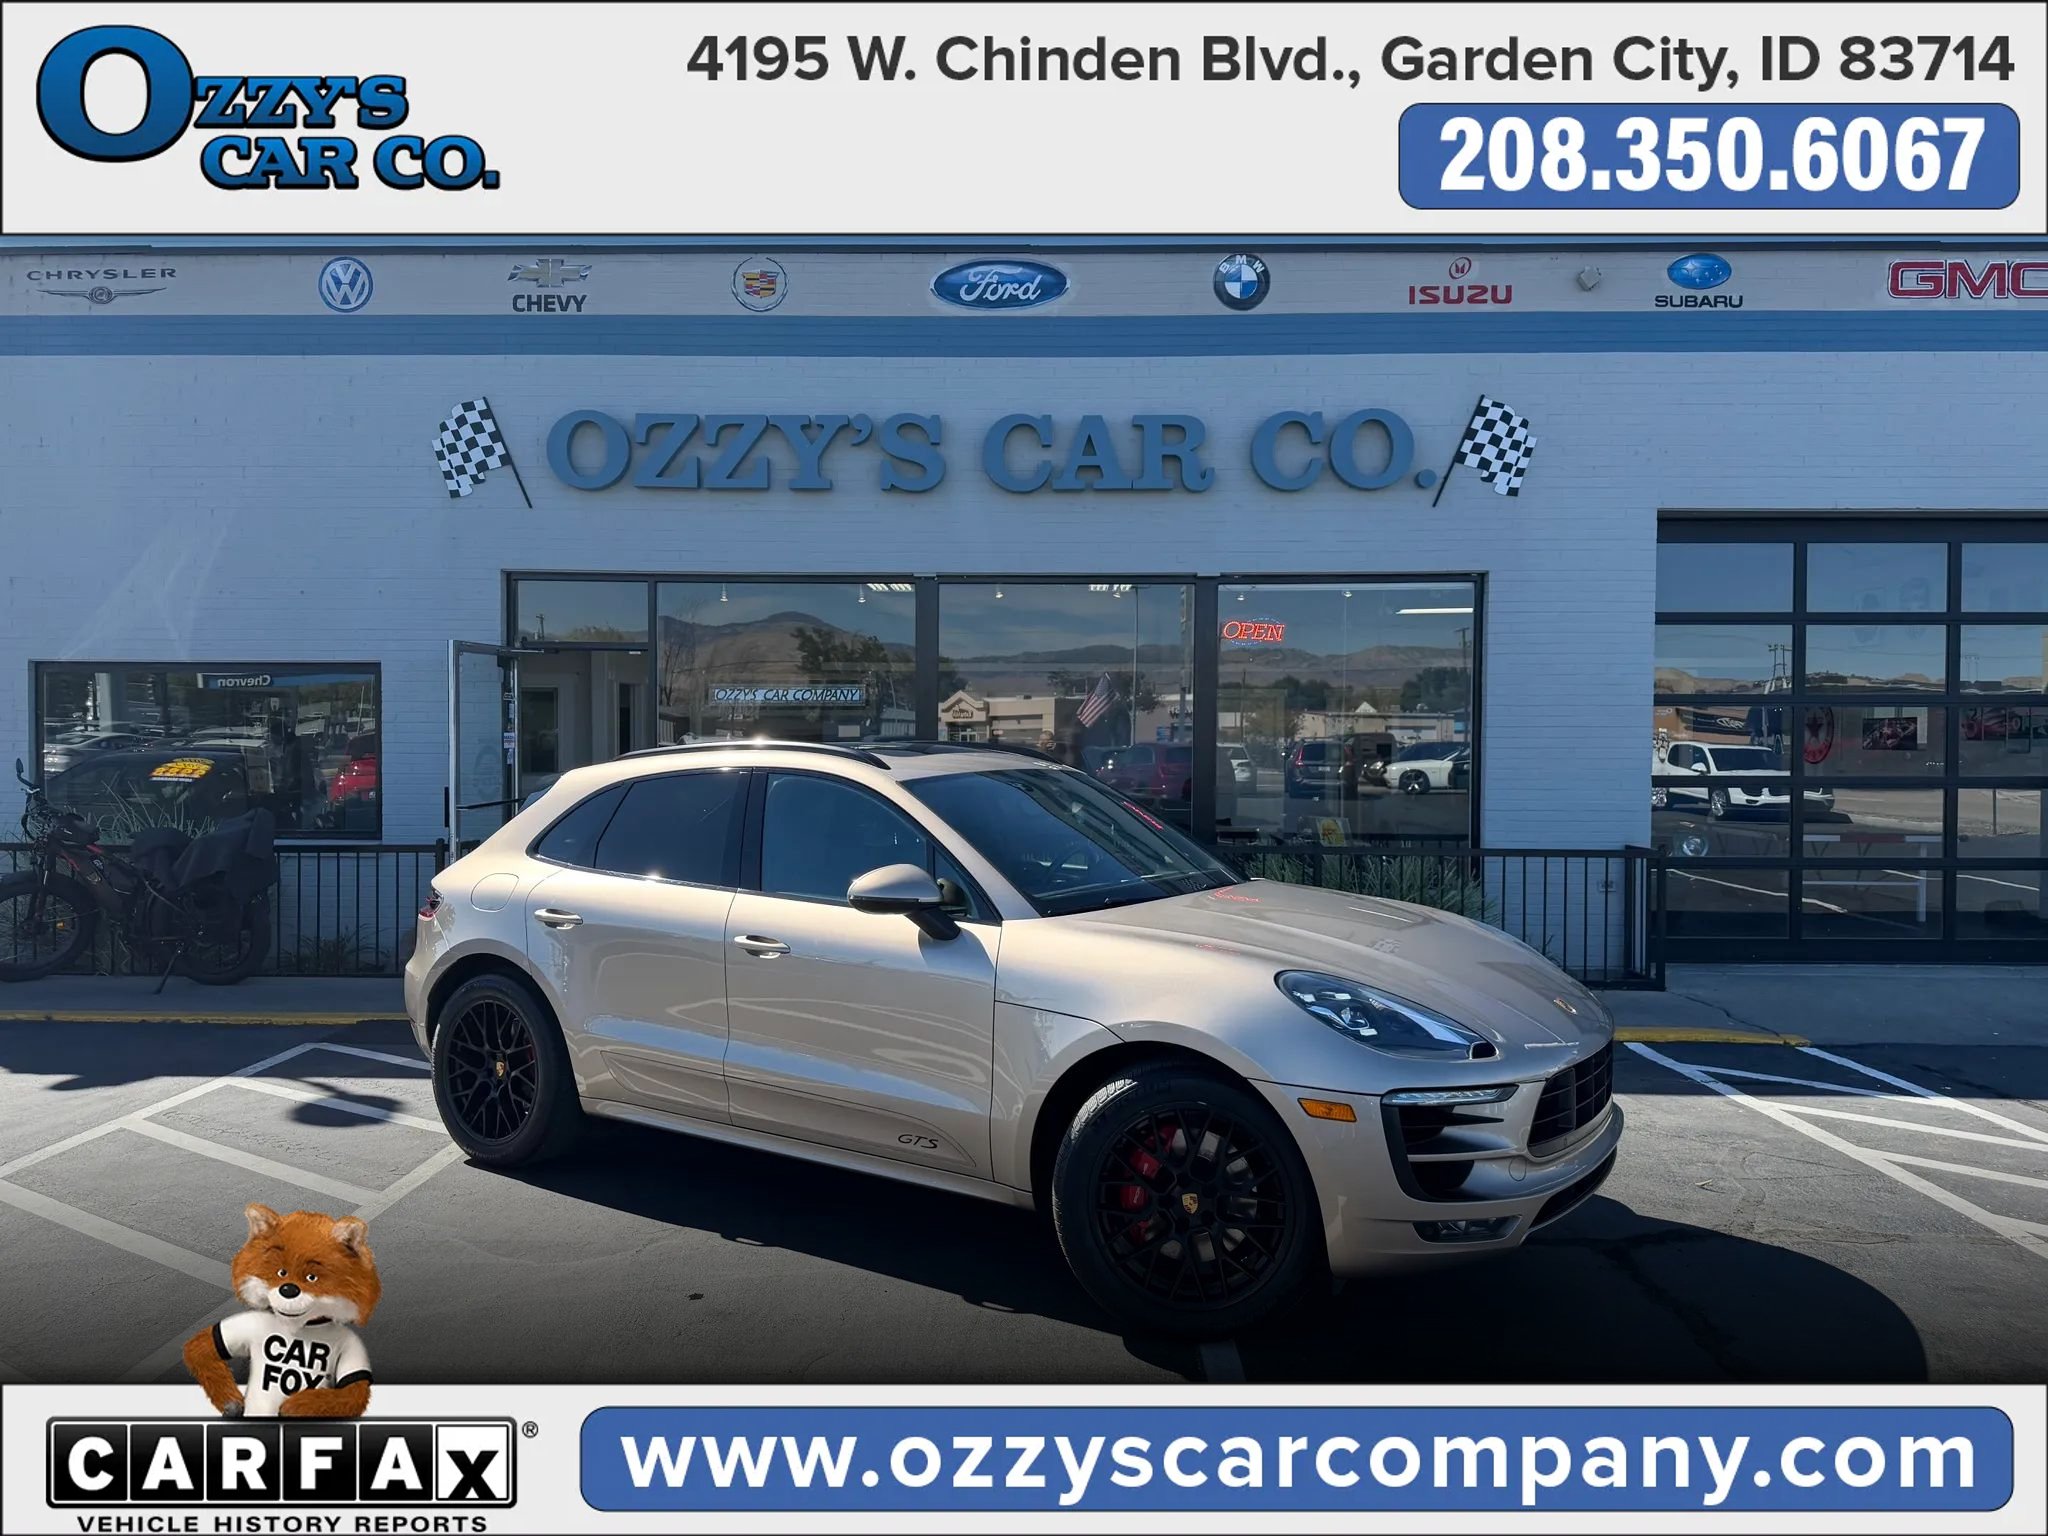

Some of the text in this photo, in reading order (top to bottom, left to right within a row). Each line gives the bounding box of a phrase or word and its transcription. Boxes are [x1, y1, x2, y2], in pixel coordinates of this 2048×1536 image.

[26, 267, 177, 282] CHRYSLER
[959, 264, 1042, 302] Ford
[1888, 259, 2048, 300] GMC
[512, 294, 587, 313] CHEVY
[1408, 284, 1513, 305] ISUZU
[1654, 294, 1744, 309] SUBARU
[982, 413, 1215, 493] CAR
[1250, 408, 1438, 492] CO.
[1222, 620, 1285, 643] OPEN
[715, 688, 860, 702] OZZY'S CAR COMPANY
[898, 1133, 939, 1149] GTS
